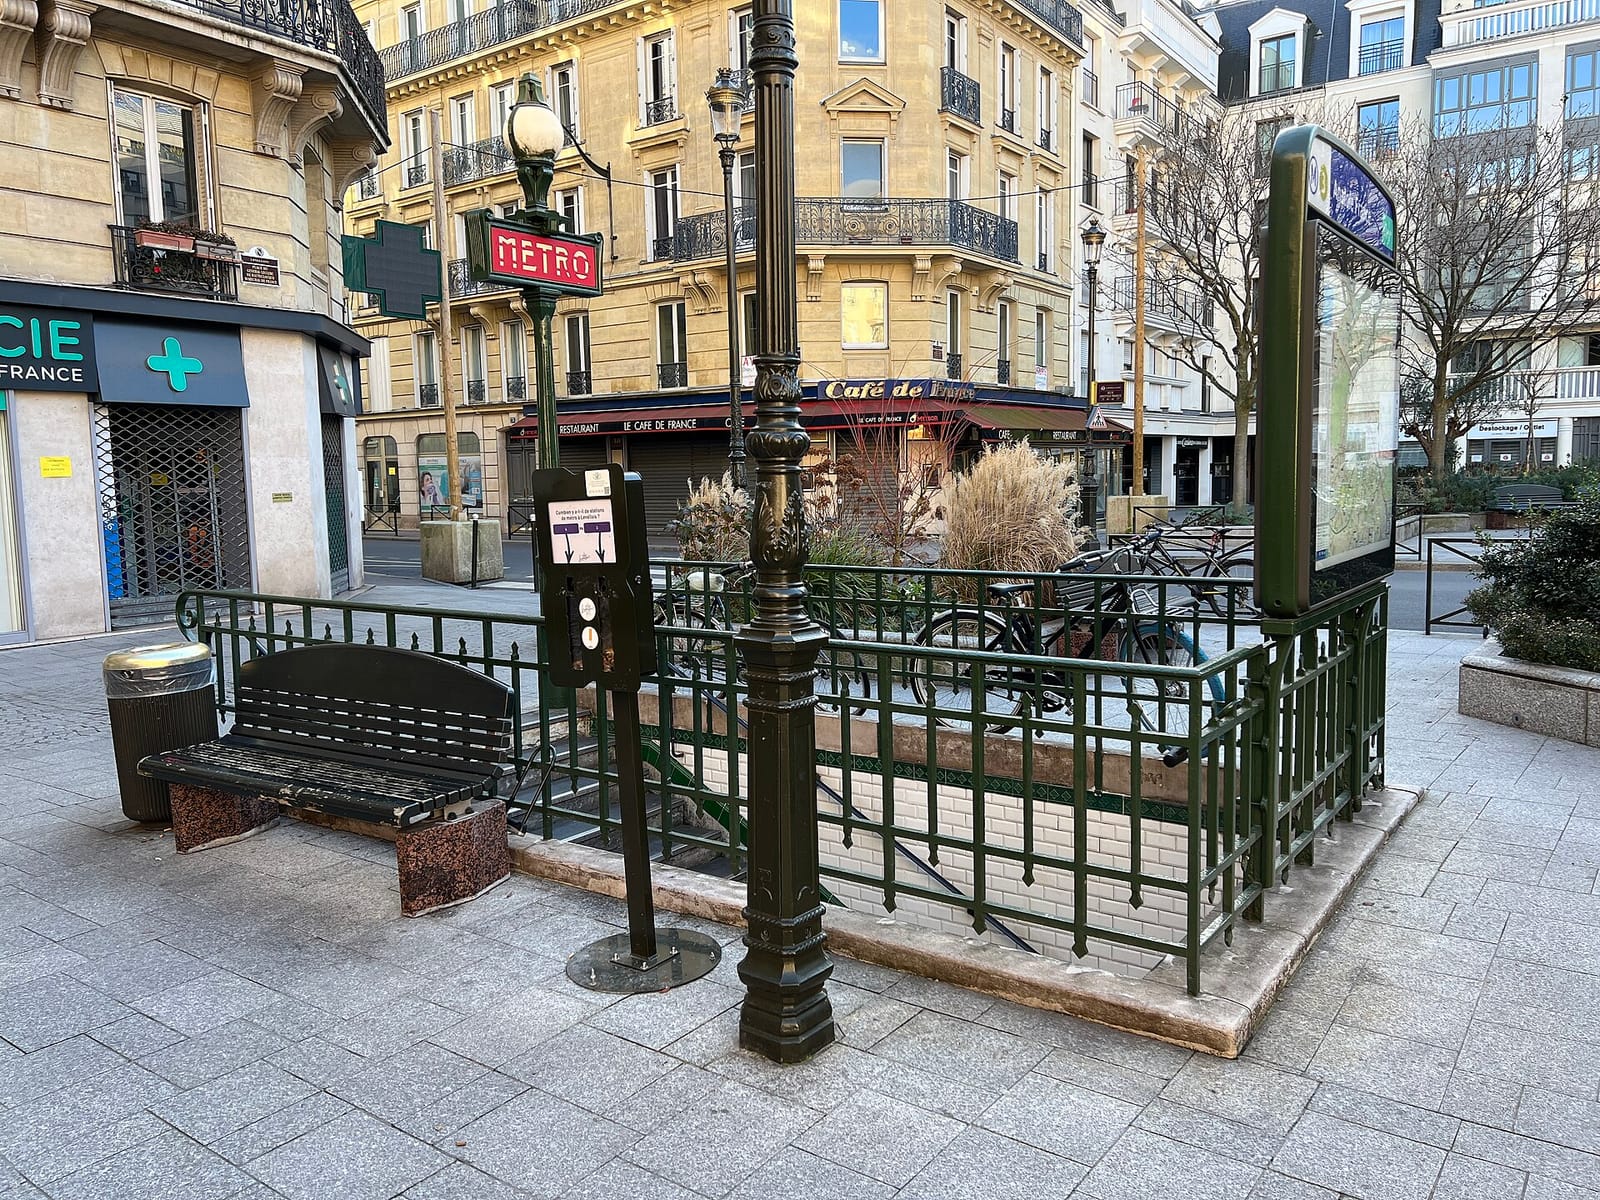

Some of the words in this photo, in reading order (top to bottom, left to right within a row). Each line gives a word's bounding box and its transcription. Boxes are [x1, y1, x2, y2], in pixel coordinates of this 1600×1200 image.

[498, 235, 589, 280] METRO
[0, 315, 83, 361] CIE
[0, 364, 83, 382] FRANCE
[825, 381, 885, 399] Café
[892, 380, 923, 399] de
[559, 423, 600, 434] RESTAURANT
[623, 421, 631, 431] LE
[634, 420, 652, 431] CAFE
[655, 420, 665, 430] DE
[667, 418, 697, 430] FRANCE
[1053, 431, 1077, 440] RESTAURANT
